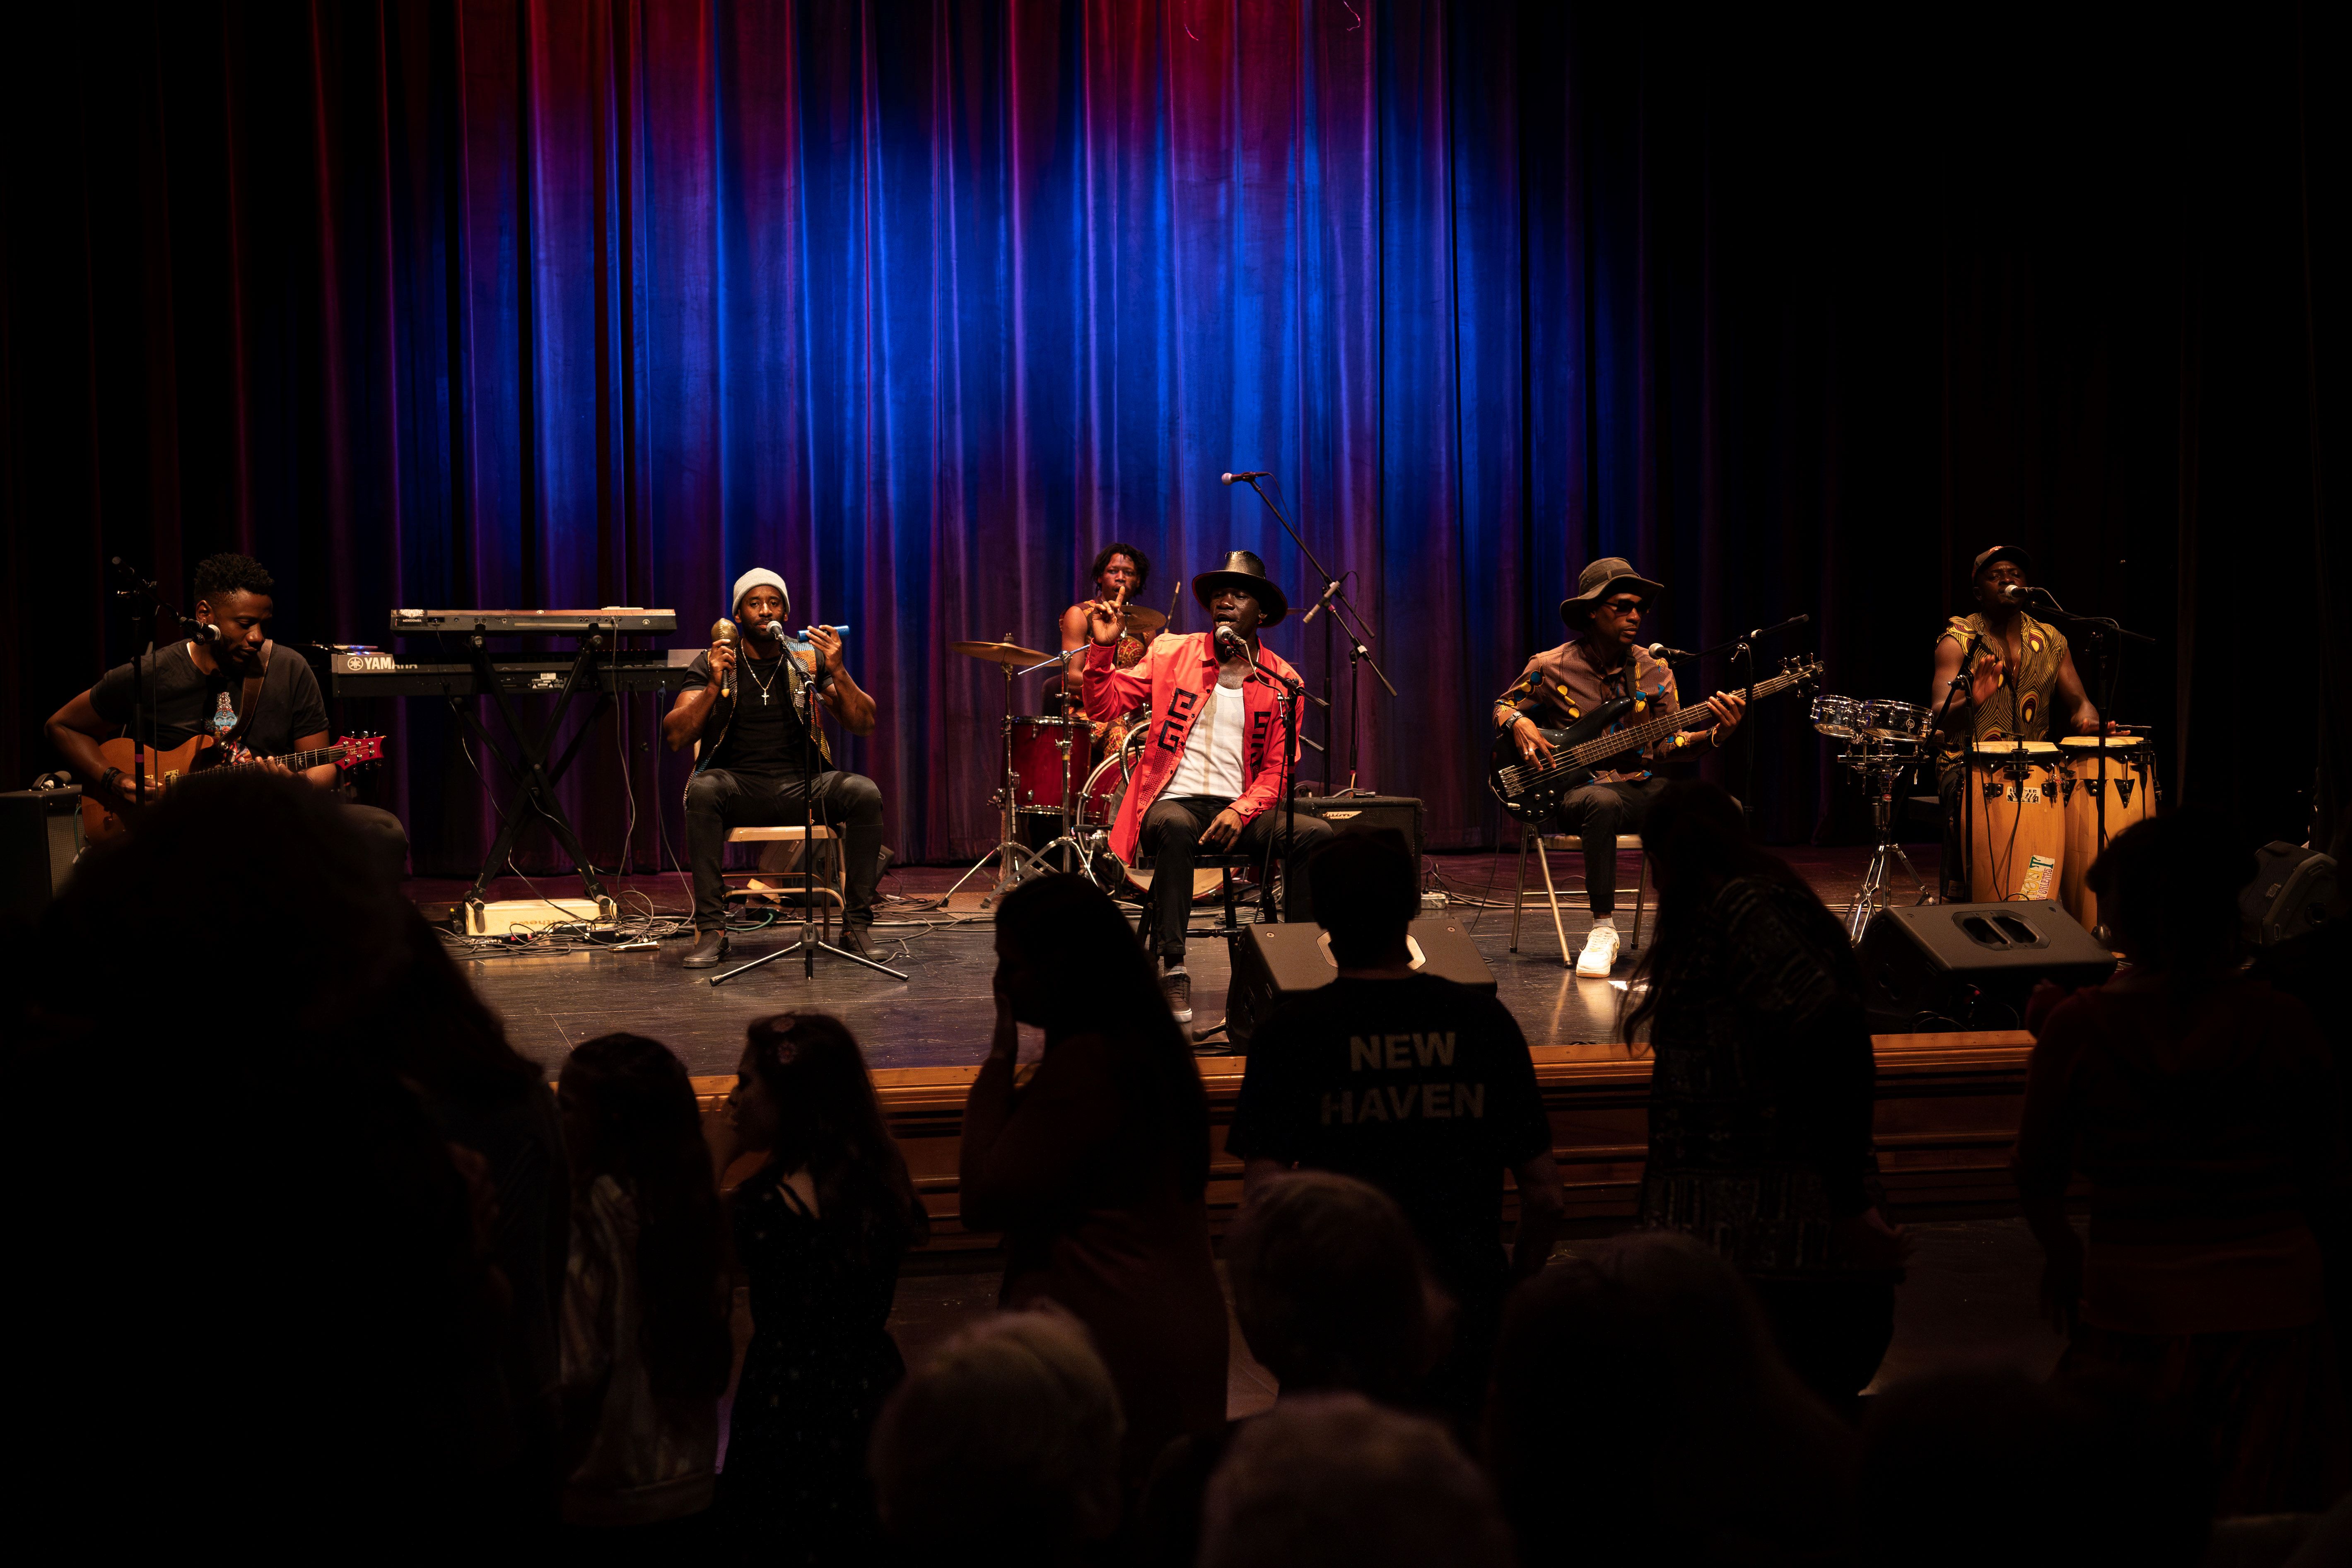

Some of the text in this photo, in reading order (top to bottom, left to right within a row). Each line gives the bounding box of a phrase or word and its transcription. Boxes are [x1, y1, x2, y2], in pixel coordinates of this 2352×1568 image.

[2038, 868, 2053, 894] ORLEANS
[1348, 1030, 1457, 1072] NEW
[1319, 1081, 1485, 1126] HAVEN
